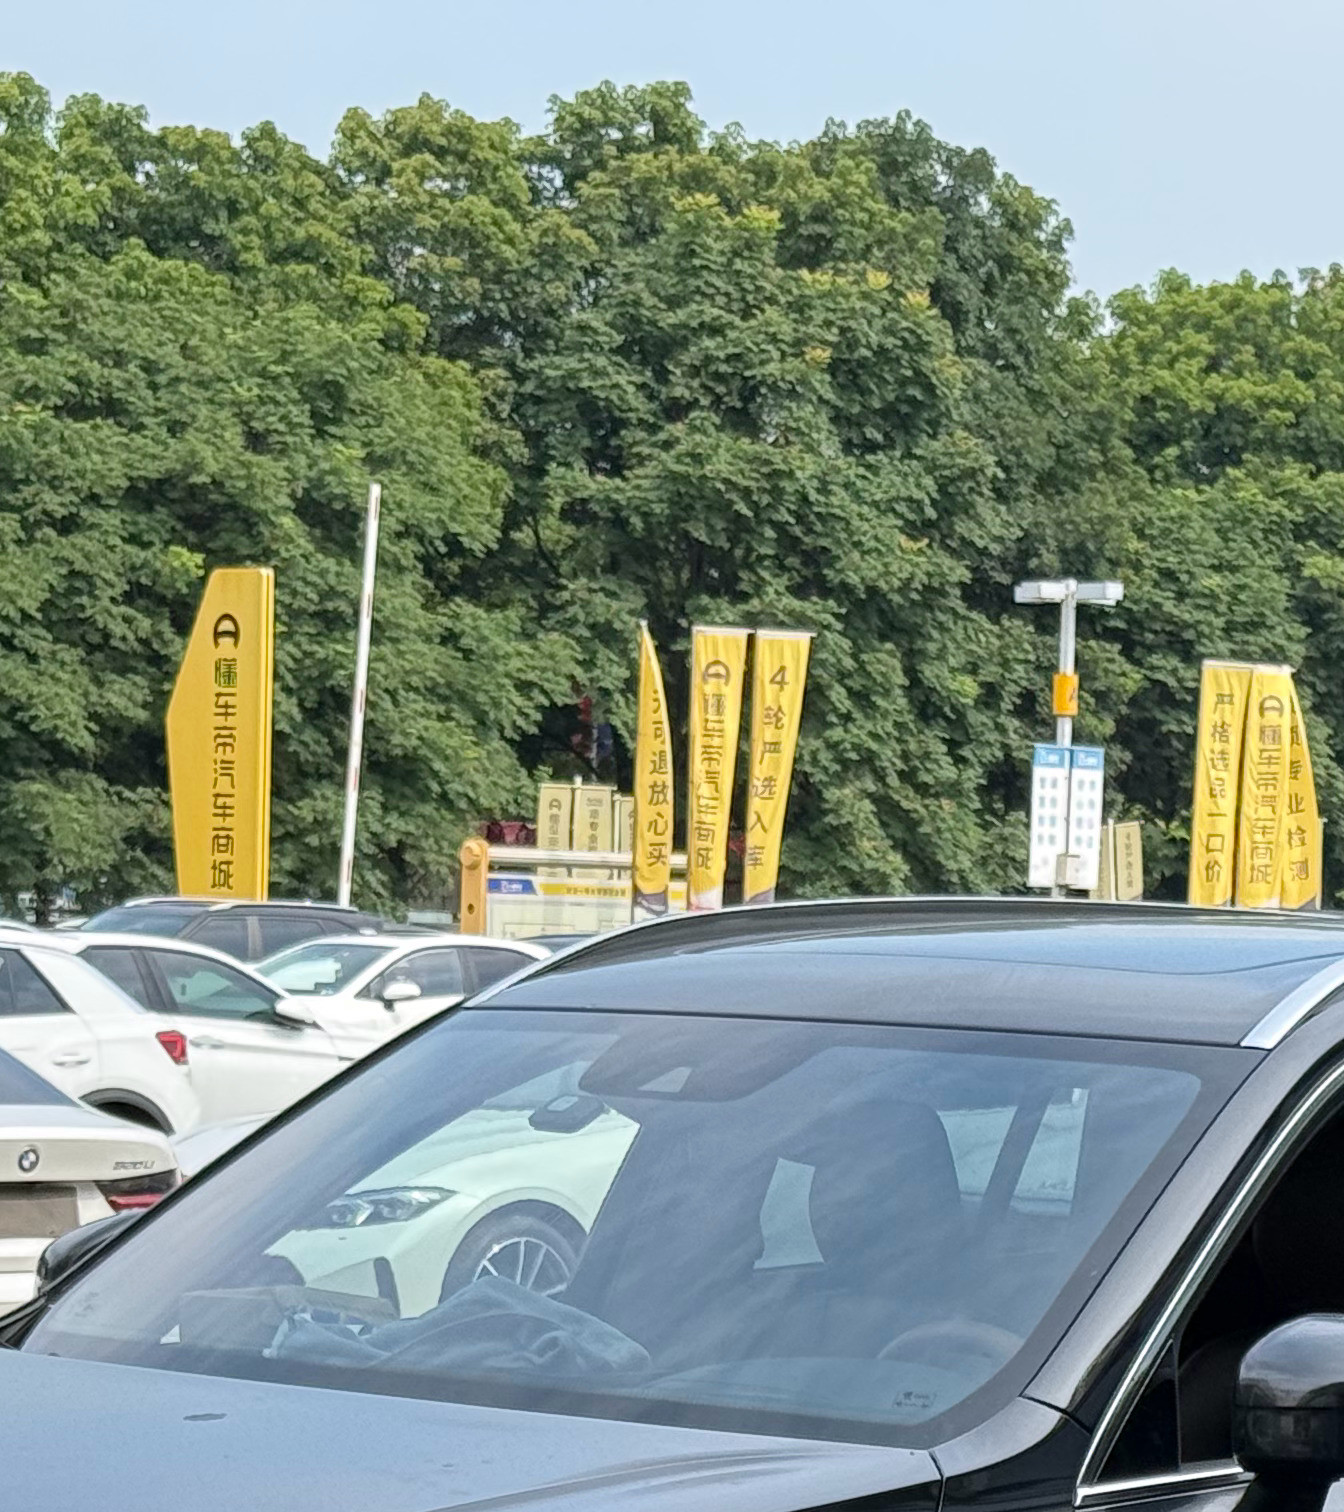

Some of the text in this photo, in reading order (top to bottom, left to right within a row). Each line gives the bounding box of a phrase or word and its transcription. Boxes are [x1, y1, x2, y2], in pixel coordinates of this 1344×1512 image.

[210, 657, 237, 891] 懂车帝汽车商城
[695, 693, 726, 870] 懂车帝汽车商城
[747, 665, 789, 870] 4轮严选入库
[1205, 692, 1234, 884] 严格选品一口价
[1249, 724, 1283, 885] 懂车帝汽车商城
